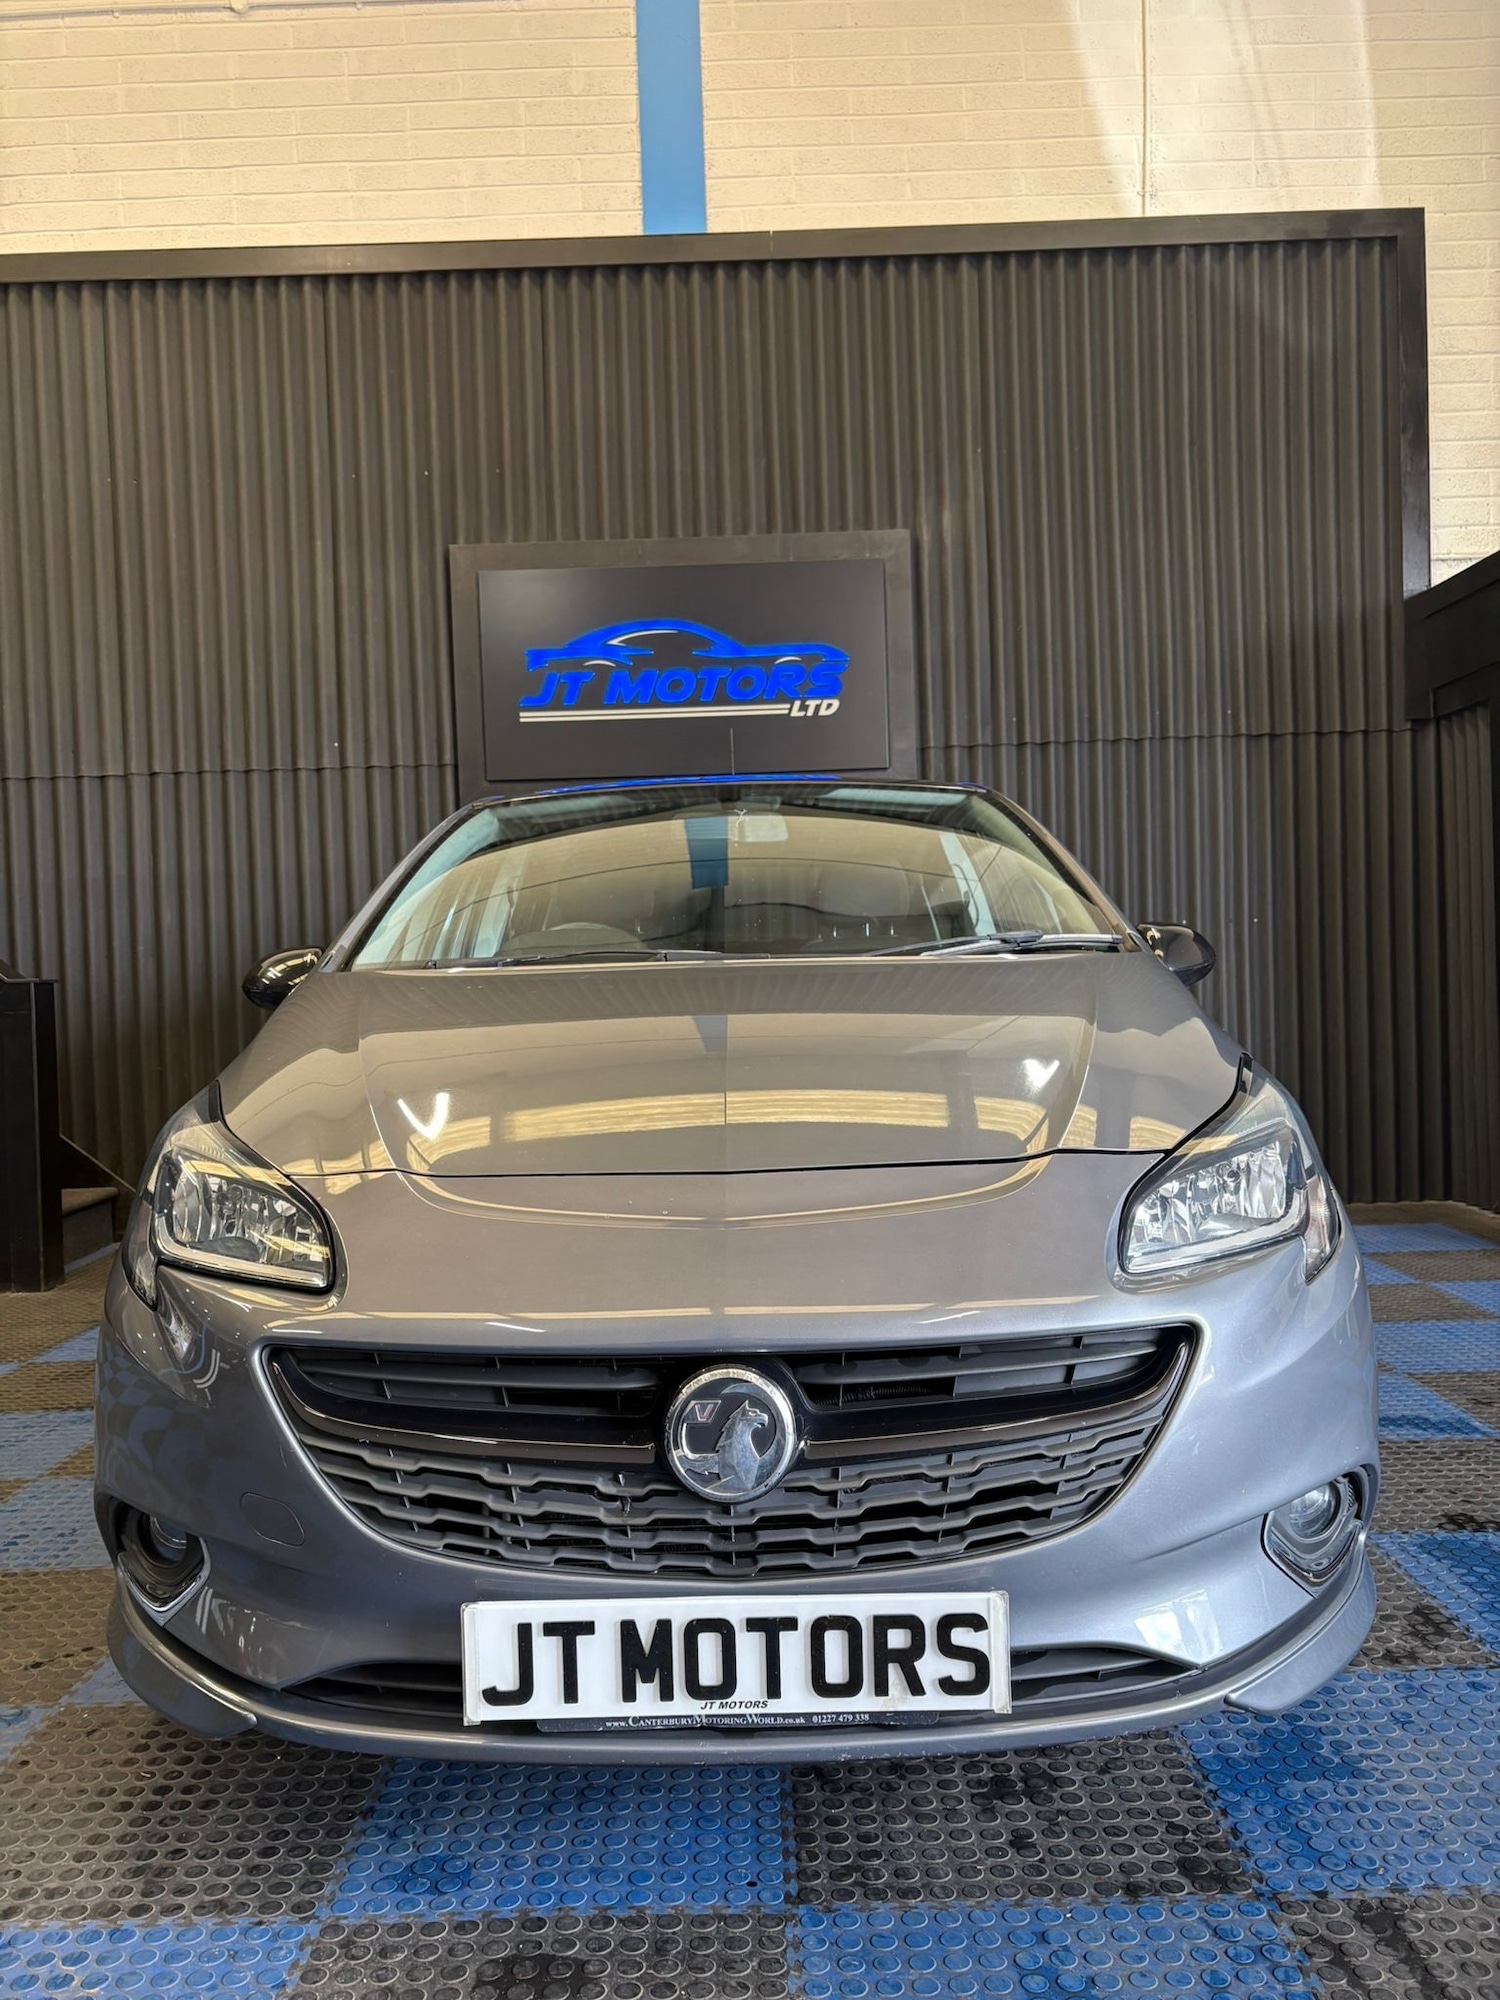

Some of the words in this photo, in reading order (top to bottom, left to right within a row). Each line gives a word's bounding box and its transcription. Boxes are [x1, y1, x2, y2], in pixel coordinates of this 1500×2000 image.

[519, 672, 595, 707] JT
[604, 665, 849, 705] MOTORS
[790, 699, 840, 717] LTD
[482, 1621, 595, 1706] JT
[620, 1613, 990, 1703] MOTORS
[700, 1701, 716, 1710] JT
[718, 1700, 768, 1709] MOTORS
[812, 1714, 836, 1723] 01227
[838, 1714, 853, 1722] 479
[855, 1713, 869, 1722] 338
